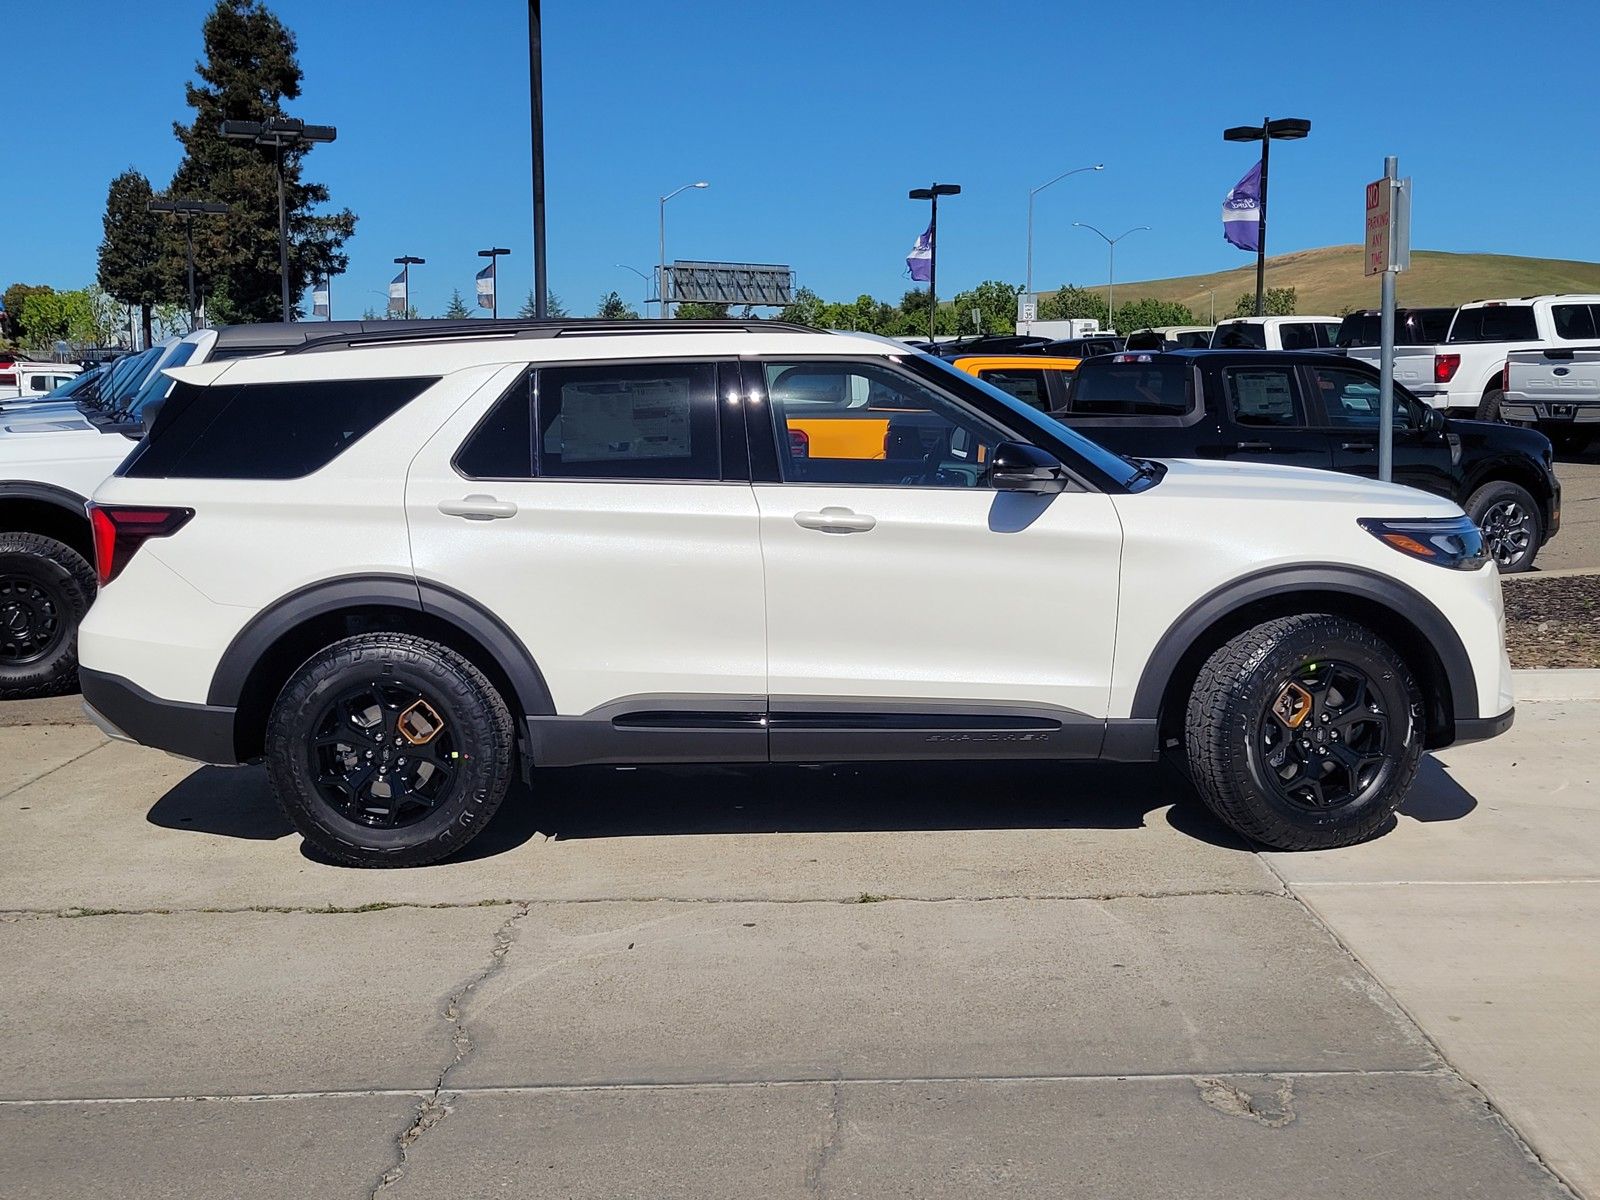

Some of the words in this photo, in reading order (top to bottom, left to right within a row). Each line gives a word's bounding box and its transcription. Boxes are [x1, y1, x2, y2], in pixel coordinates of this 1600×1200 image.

[1367, 184, 1379, 208] NO
[1367, 211, 1389, 231] PARKING
[1372, 234, 1383, 247] ANY
[1371, 251, 1383, 265] TIME
[1024, 311, 1033, 319] 35
